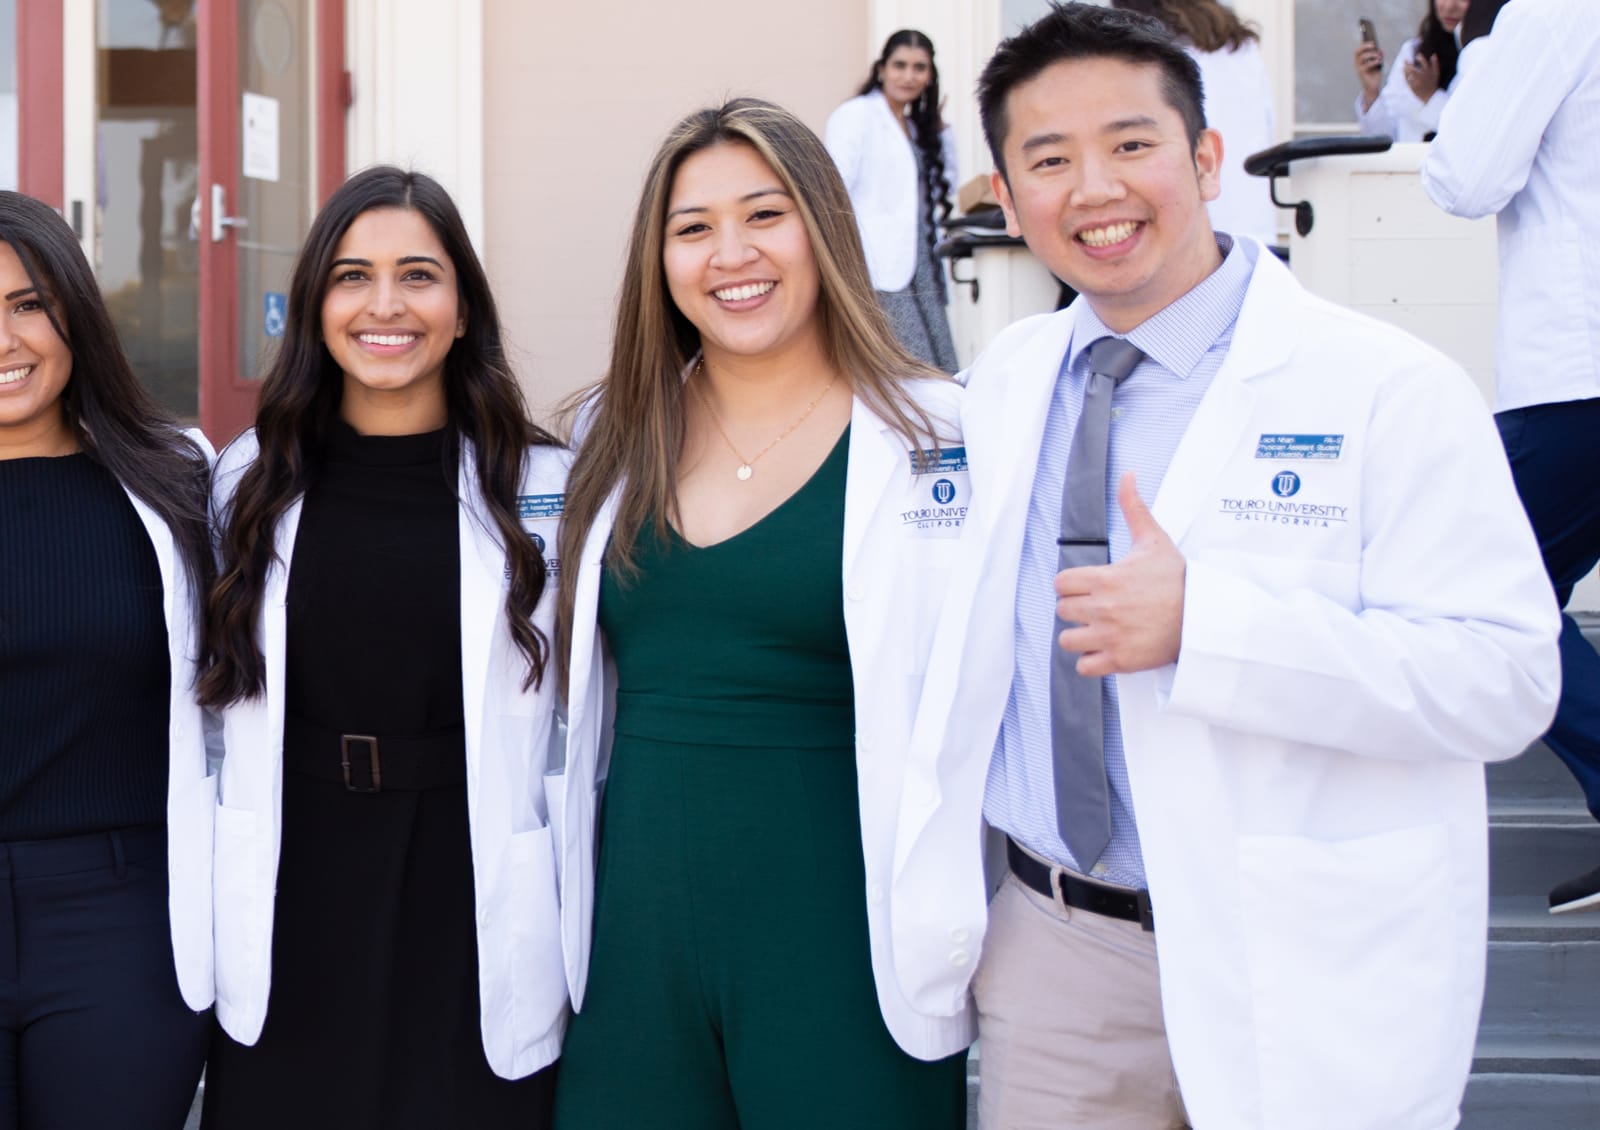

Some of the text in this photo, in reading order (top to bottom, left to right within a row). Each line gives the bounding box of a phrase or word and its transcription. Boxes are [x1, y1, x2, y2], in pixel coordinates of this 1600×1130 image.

[1220, 498, 1348, 518] TOURO UNIVERSITY
[1235, 513, 1329, 528] CALIFORNIA
